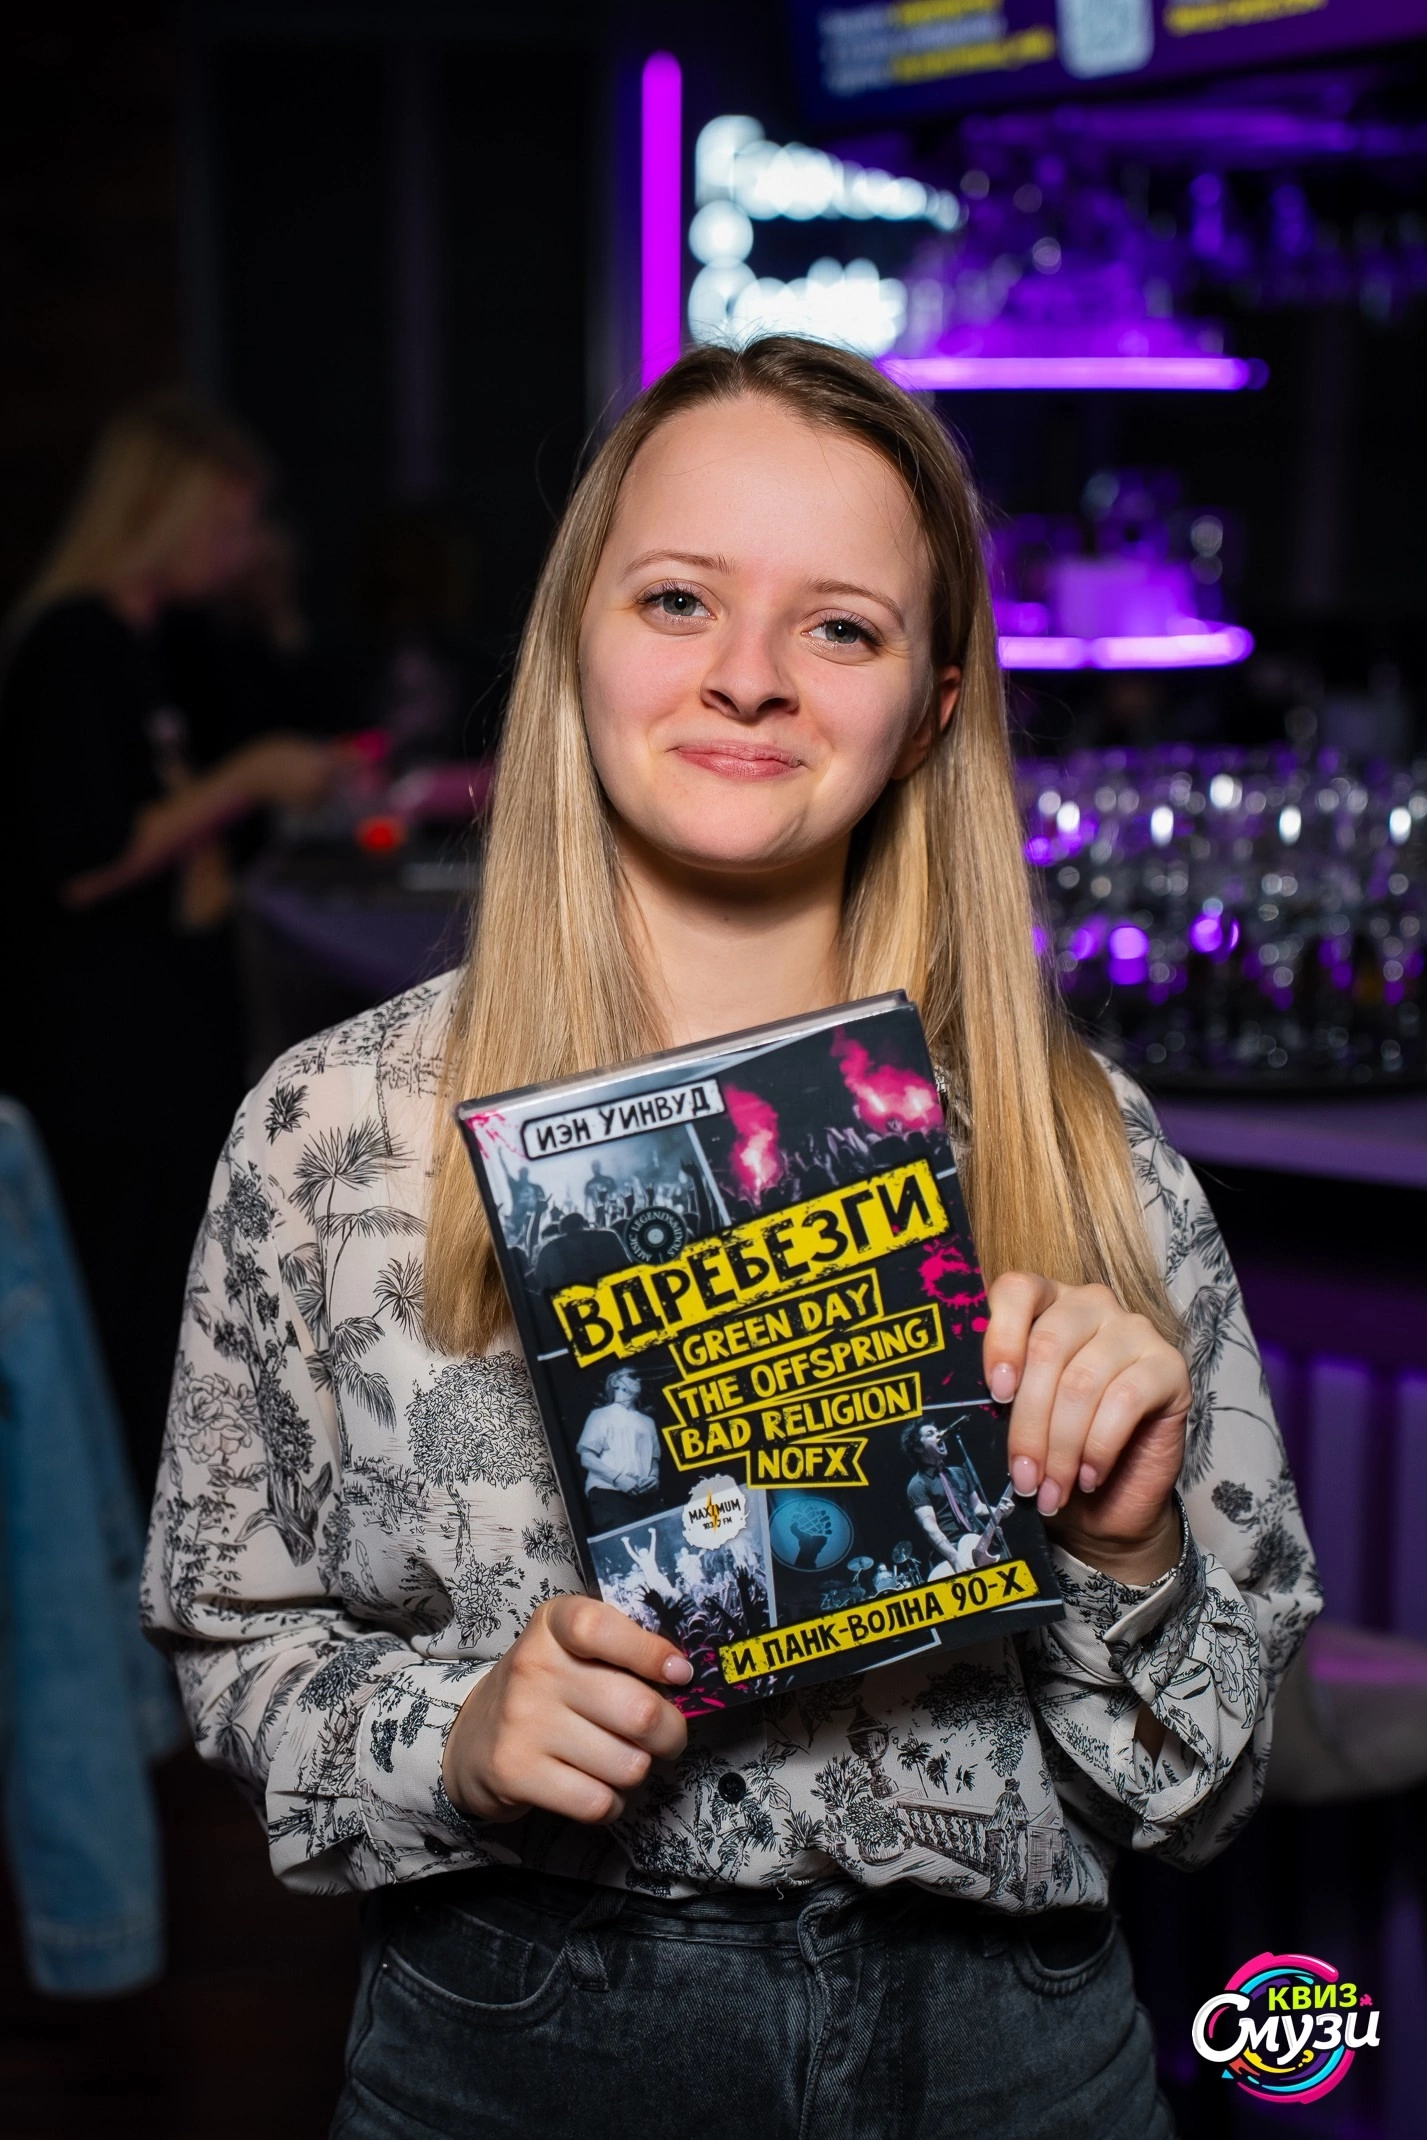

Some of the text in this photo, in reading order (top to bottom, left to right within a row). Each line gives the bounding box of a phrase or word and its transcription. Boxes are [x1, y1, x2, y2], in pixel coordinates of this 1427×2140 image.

[536, 1087, 711, 1151] ИЭН УИНВУД
[561, 1173, 928, 1356] ВДРЕБЕЗГИ
[683, 1283, 870, 1366] GREEN DAY
[678, 1318, 929, 1418] THE OFFSPRING
[680, 1382, 911, 1459] BAD RELIGION
[758, 1447, 849, 1480] NOFX
[688, 1498, 741, 1524] MAXIMUM
[722, 1516, 732, 1525] FM
[730, 1647, 756, 1676] И
